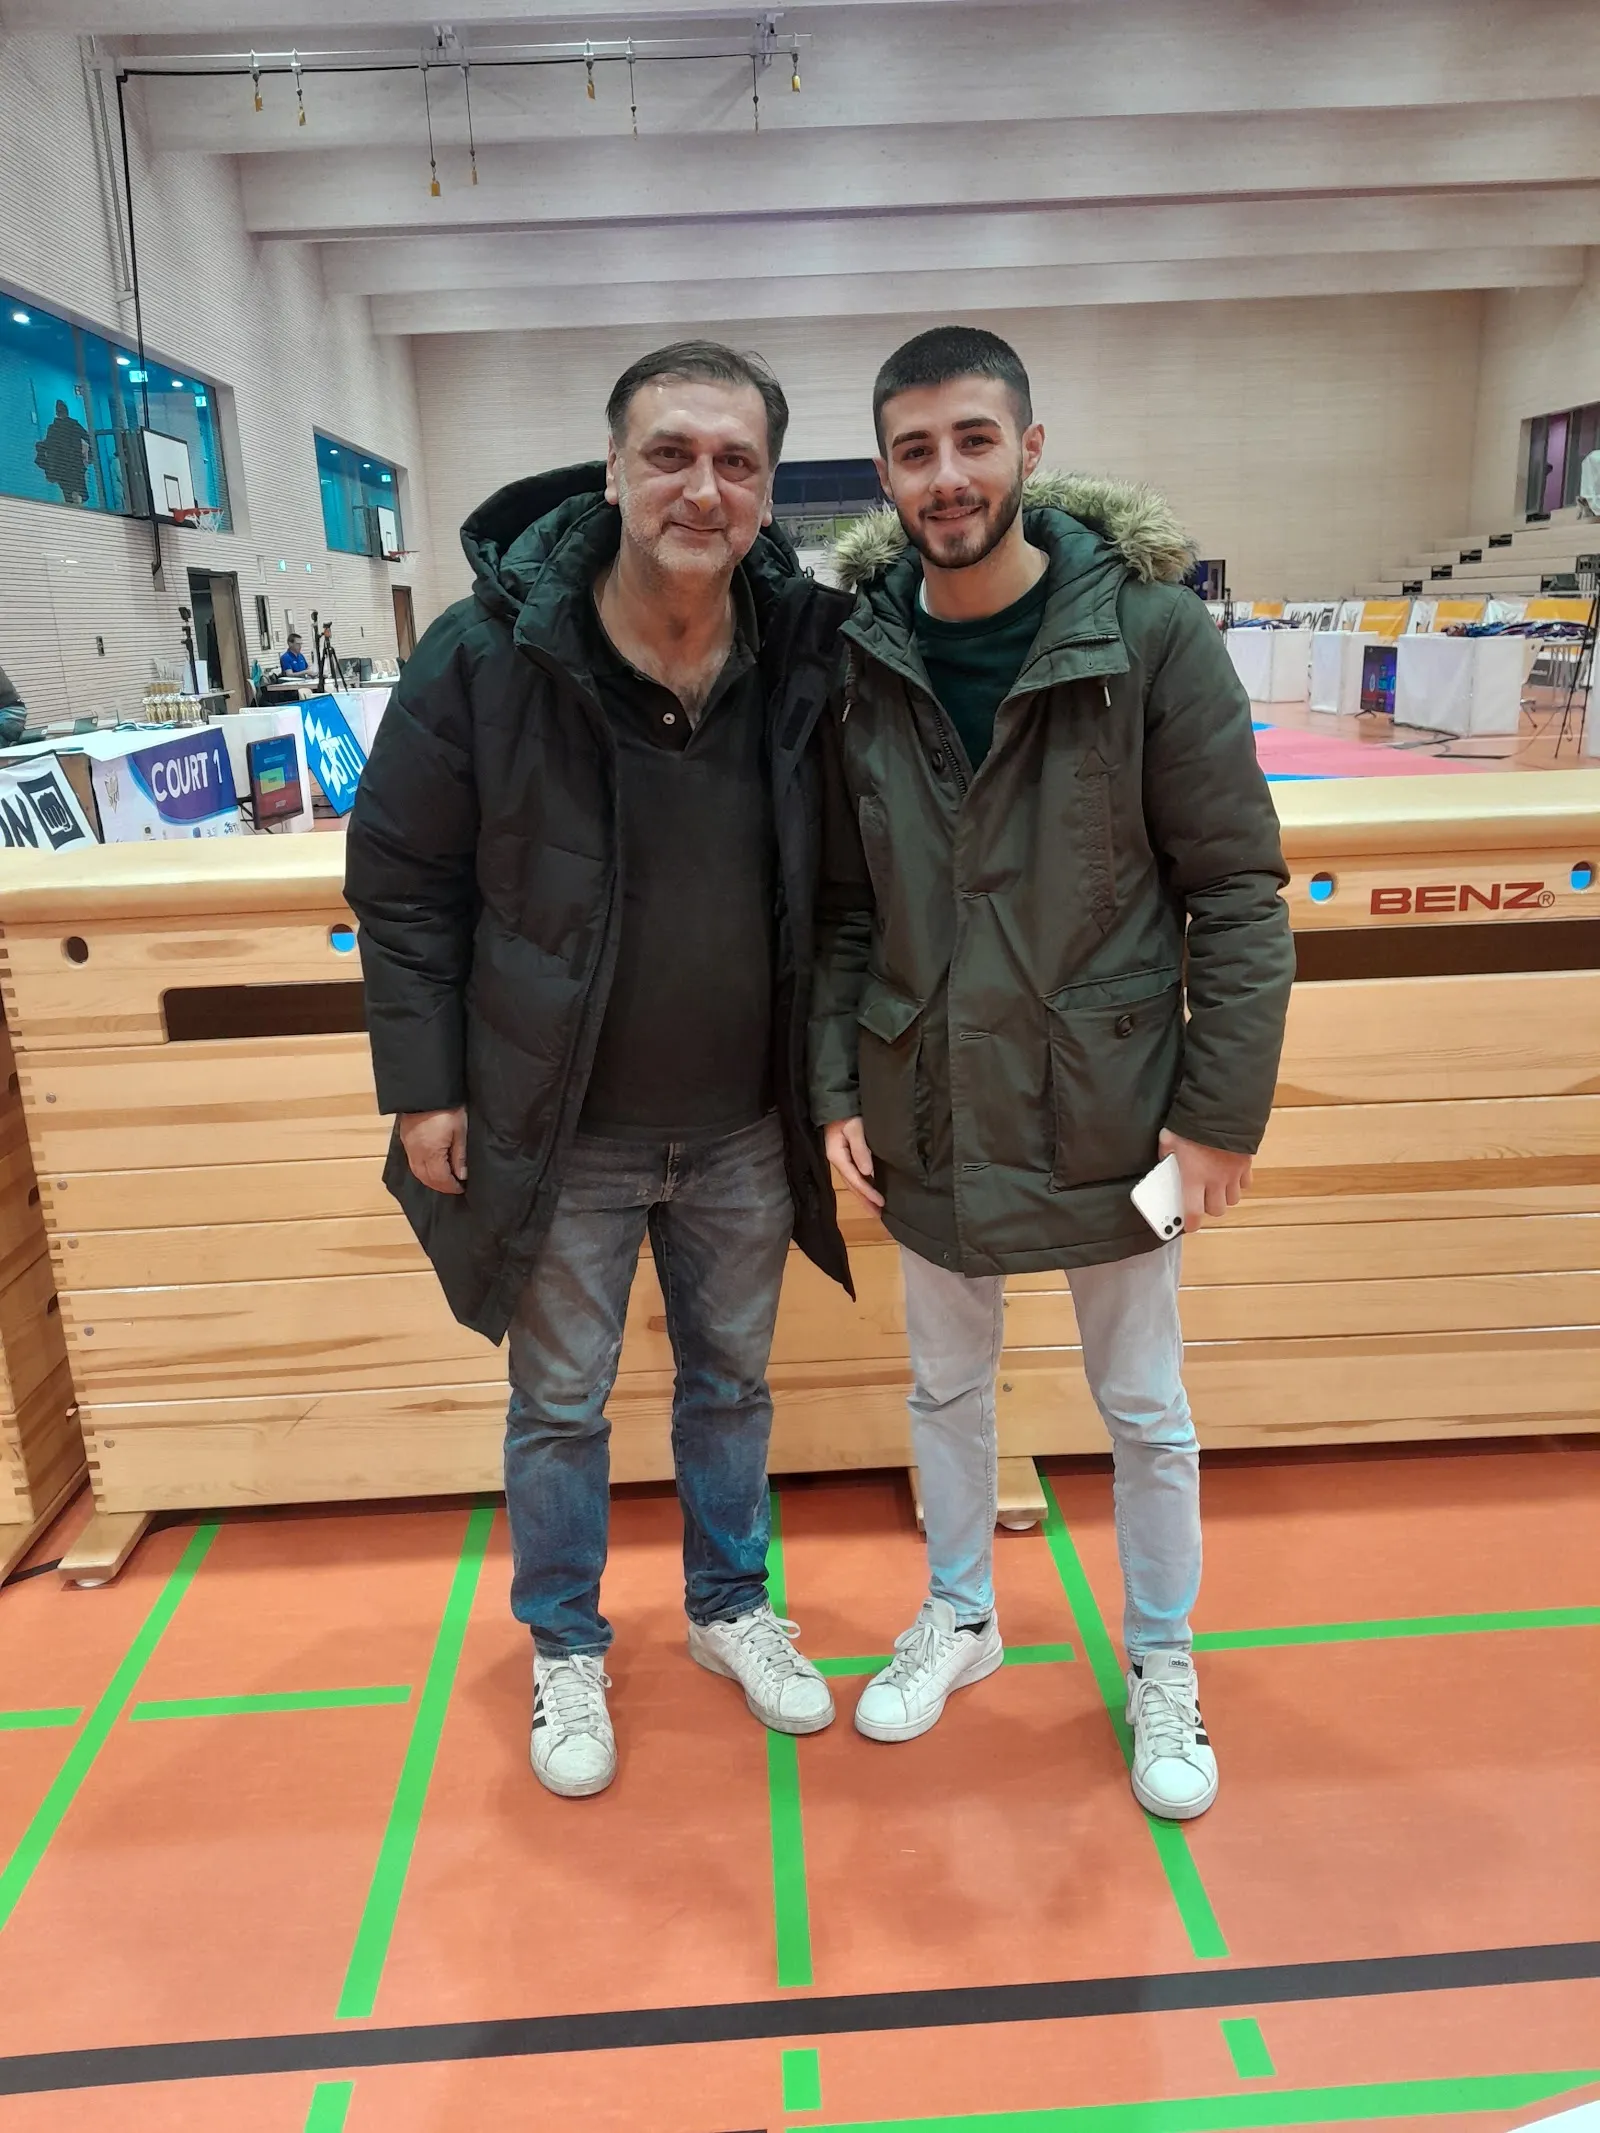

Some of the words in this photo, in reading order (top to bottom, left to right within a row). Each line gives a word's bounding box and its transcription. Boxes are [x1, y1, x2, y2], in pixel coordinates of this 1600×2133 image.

[151, 751, 208, 802] COURT
[213, 748, 223, 784] 1
[320, 733, 364, 785] BTU
[1171, 1659, 1189, 1667] adida
